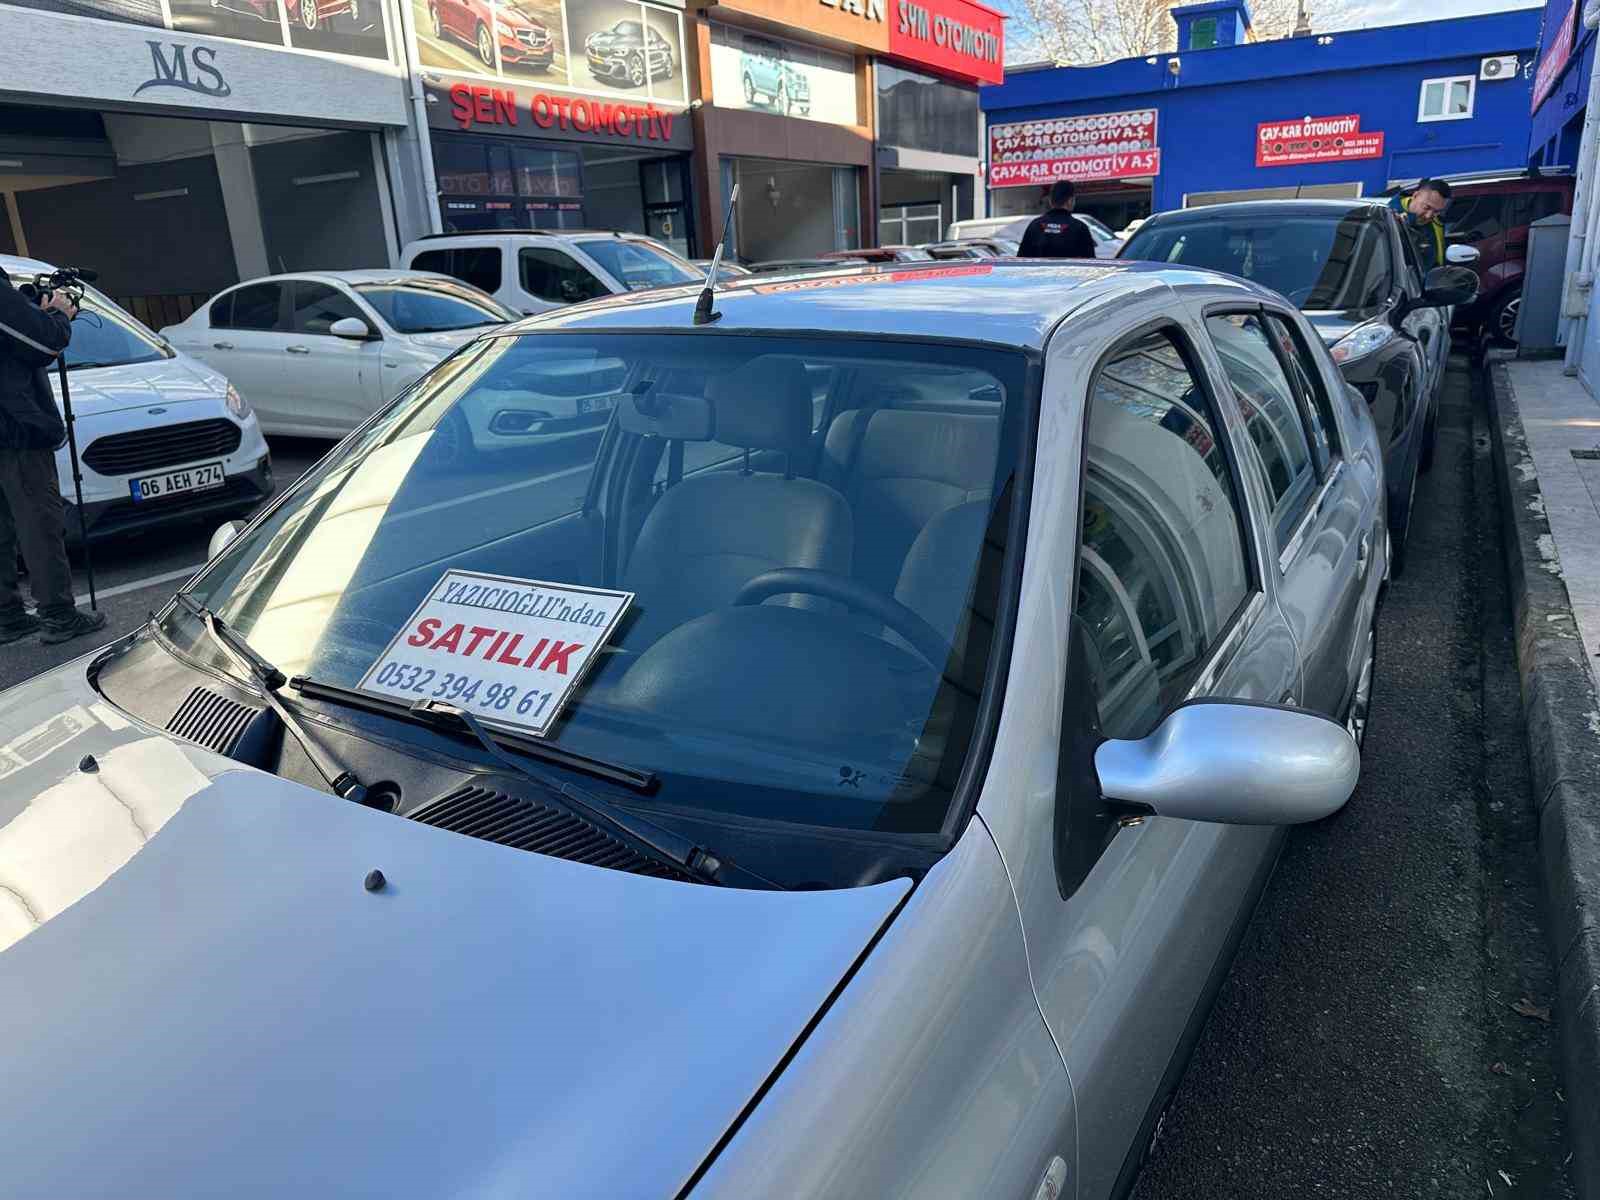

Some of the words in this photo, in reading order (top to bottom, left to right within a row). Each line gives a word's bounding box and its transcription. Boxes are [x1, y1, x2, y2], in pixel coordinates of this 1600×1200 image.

[897, 3, 929, 42] SYM
[933, 15, 999, 64] OTOMOTİV
[143, 40, 225, 92] MS
[450, 83, 518, 130] ŞEN
[531, 92, 673, 142] OTOMOTİV
[1260, 123, 1302, 144] ÇAY-KAR
[1303, 116, 1357, 136] OTOMOTİV
[996, 134, 1051, 153] ÇAY-KAR
[1052, 127, 1121, 144] OTOMOTİV
[991, 161, 1049, 183] ÇAY-KAR
[1051, 154, 1129, 175] OTOMOTİV
[140, 479, 160, 497] 06
[165, 474, 192, 492] AEH
[195, 467, 223, 486] 274
[439, 582, 606, 627] YAZICIOĞLU'ndan
[408, 618, 584, 675] SATILIK
[376, 662, 436, 693] 0532
[432, 676, 484, 704] 394
[486, 683, 518, 710] 98
[516, 690, 553, 717] 61
